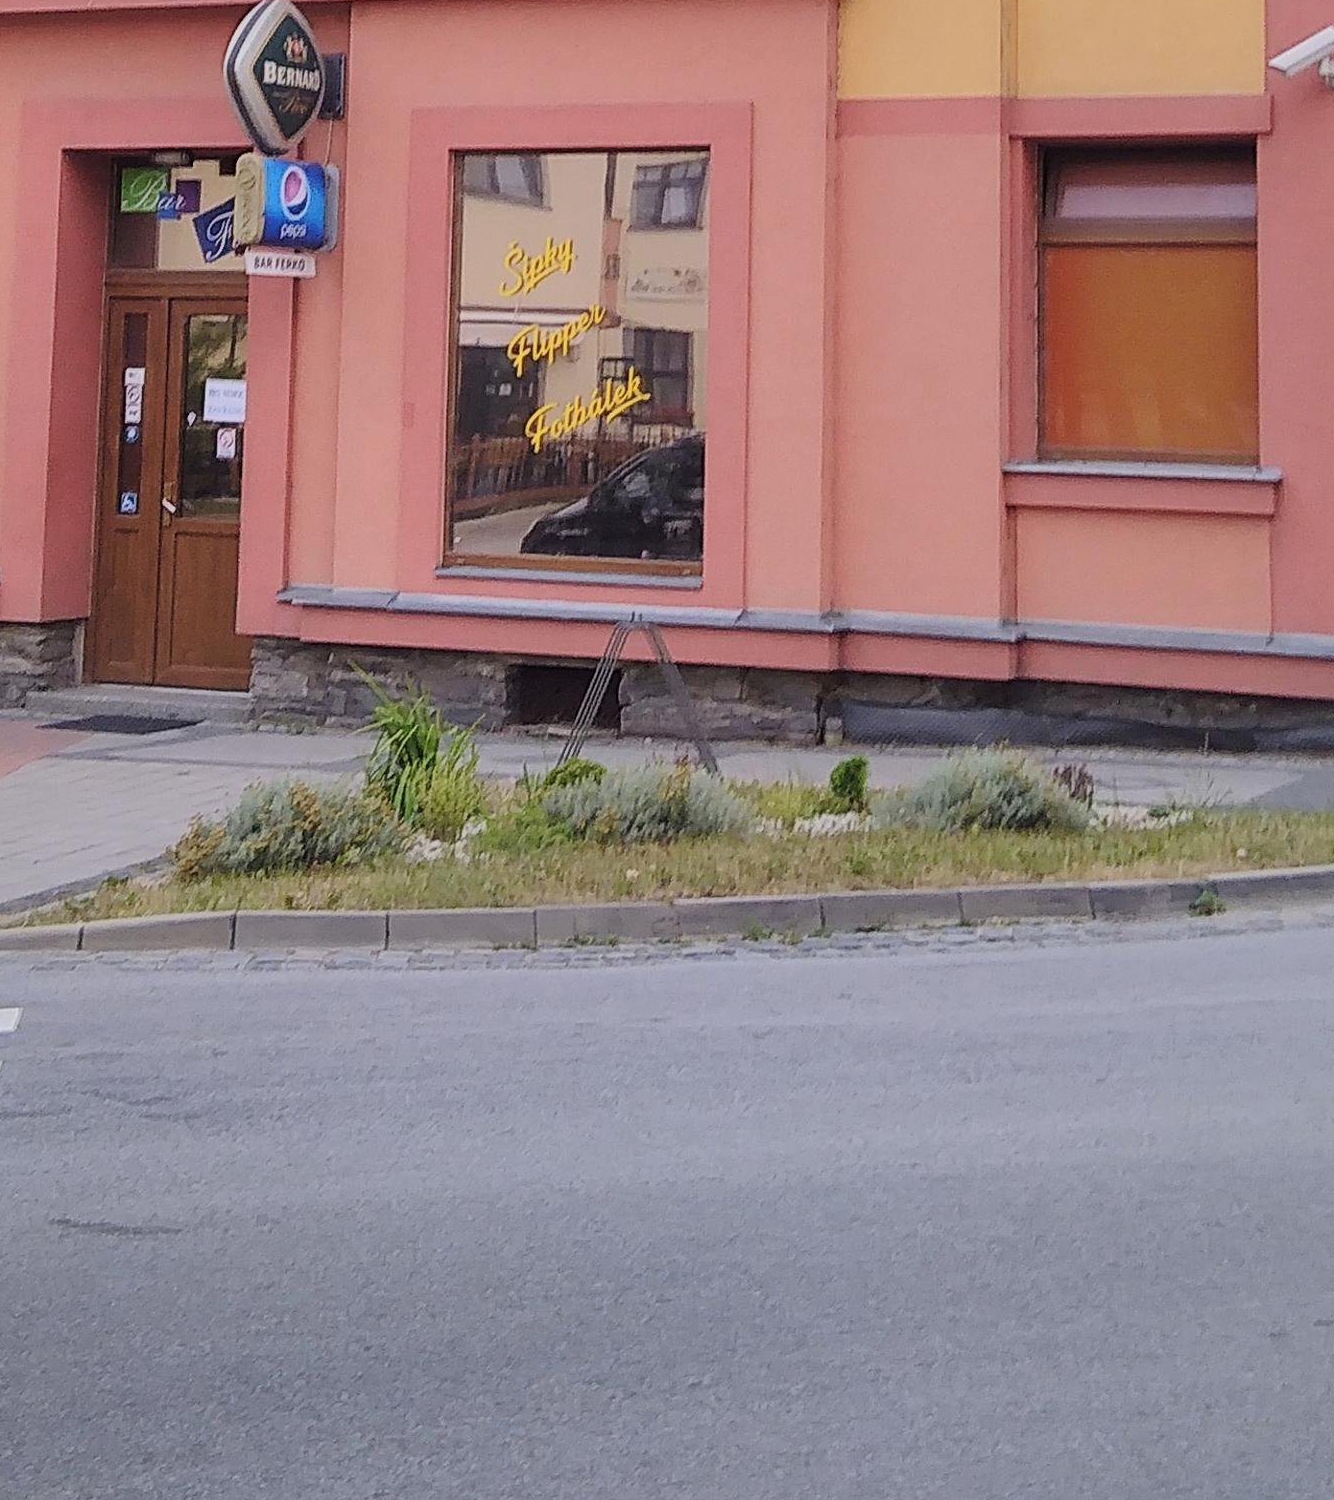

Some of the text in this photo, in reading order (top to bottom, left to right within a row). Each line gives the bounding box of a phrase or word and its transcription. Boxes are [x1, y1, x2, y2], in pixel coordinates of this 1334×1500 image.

[263, 59, 321, 92] BERNARD
[121, 170, 186, 213] Bar
[279, 223, 307, 240] pepsi
[253, 255, 306, 272] BAR FERKO
[499, 236, 574, 297] Šipky
[507, 303, 606, 378] Flipper
[525, 365, 652, 454] Fotbálek
